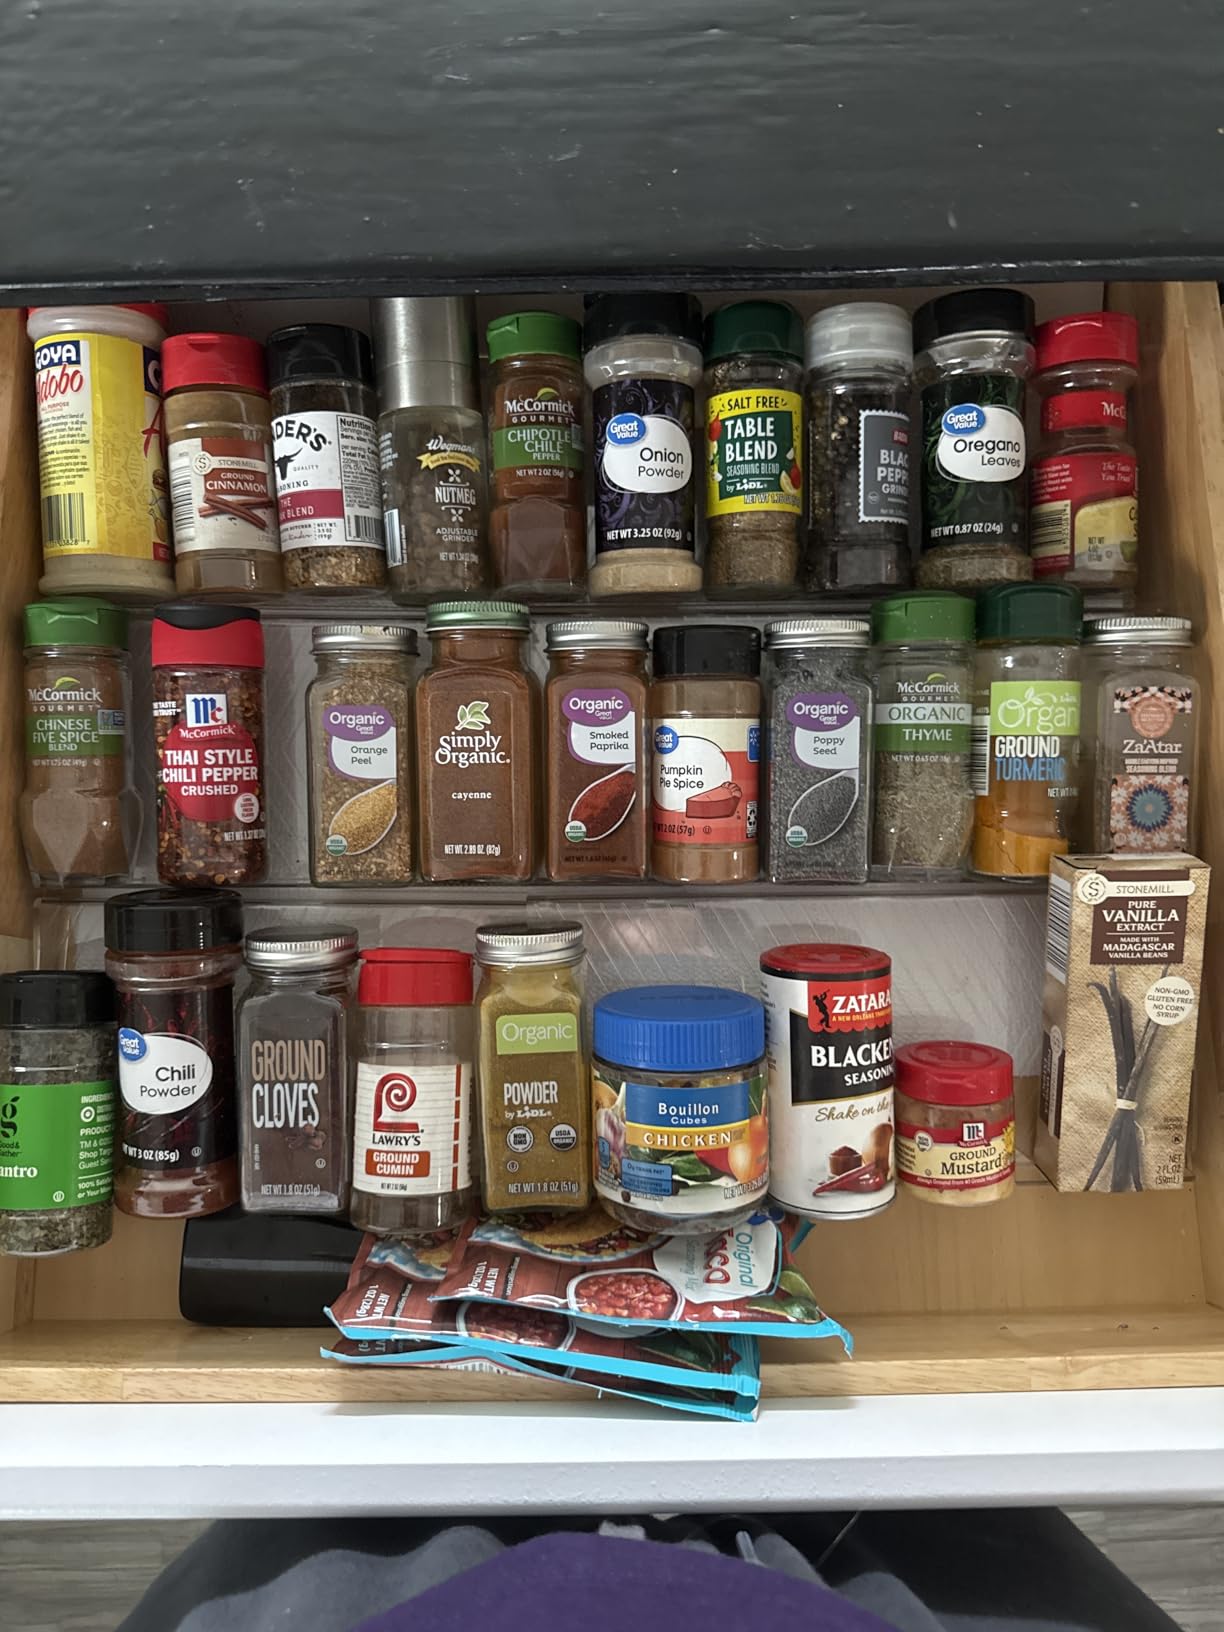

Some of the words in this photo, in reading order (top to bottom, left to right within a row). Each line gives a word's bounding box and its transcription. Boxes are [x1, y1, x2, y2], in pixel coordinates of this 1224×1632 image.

[35, 344, 77, 370] GOYA
[504, 397, 575, 417] McCormick
[727, 396, 752, 411] SALT
[755, 395, 780, 409] FREE
[511, 415, 569, 424] GOURMET
[946, 410, 978, 425] Great
[610, 420, 638, 435] Great
[725, 416, 775, 440] TABLE
[953, 419, 978, 430] Value
[507, 428, 571, 443] CHIPOTLE
[616, 428, 639, 439] Value
[524, 440, 564, 454] CHILE
[725, 440, 778, 463] BLEND
[953, 438, 1020, 457] Oregano
[533, 452, 561, 461] PEPPER
[639, 447, 684, 465] Onion
[981, 454, 1021, 468] Leaves
[293, 464, 319, 472] QUALITY
[516, 468, 526, 477] NET
[527, 469, 537, 477] WT
[638, 465, 684, 479] Powder
[726, 463, 760, 478] SEASONING
[760, 463, 780, 475] BLEND
[220, 472, 255, 481] GROUND
[206, 480, 267, 493] CINNAMON
[726, 484, 736, 493] by
[435, 486, 476, 505] NUTMEG
[286, 505, 314, 519] BLEND
[436, 527, 478, 536] ADJUSTABLE
[606, 528, 619, 541] NET
[619, 528, 632, 540] WT
[632, 528, 652, 539] 3.25
[652, 527, 663, 539] OZ
[663, 527, 682, 541] (92g)
[930, 523, 943, 538] NET
[943, 524, 955, 535] WT
[955, 523, 972, 535] 0.87
[972, 523, 984, 533] OZ
[984, 522, 1004, 534] (24g)
[442, 534, 475, 543] GRINDER
[896, 681, 961, 694] McCormick
[28, 687, 104, 703] McCormick
[33, 704, 95, 713] GOURMET
[569, 696, 624, 714] Organic
[793, 701, 849, 719] Organic
[329, 711, 385, 728] Organic
[888, 706, 966, 721] ORGANIC
[36, 719, 92, 731] CHINESE
[32, 731, 56, 743] FIVE
[59, 731, 100, 743] SPICE
[179, 725, 235, 739] McCormick
[590, 731, 629, 740] Smoked
[655, 732, 673, 743] Great
[902, 728, 953, 741] THYME
[48, 743, 78, 752] BLEND
[439, 730, 502, 755] Simply
[590, 742, 629, 752] Paprika
[813, 736, 845, 746] Poppy
[995, 735, 1060, 758] GROUND
[1121, 739, 1183, 754] Za'Atar
[164, 749, 199, 766] THAI
[204, 748, 253, 766] STYLE
[351, 746, 388, 756] Orange
[813, 746, 837, 755] Seed
[351, 757, 372, 765] Peel
[162, 768, 197, 783] CHILI
[201, 766, 259, 783] PEPPER
[660, 765, 703, 777] Pumpkin
[180, 784, 239, 796] CRUSHED
[660, 777, 671, 788] Pie
[673, 778, 704, 790] Spice
[451, 791, 492, 801] cayenne
[677, 825, 695, 836] (57g)
[444, 844, 454, 855] NET
[1116, 885, 1173, 894] STONEMILL
[1128, 900, 1157, 909] PURE
[1102, 909, 1180, 922] VANILLA
[1116, 922, 1165, 932] EXTRACT
[1102, 942, 1175, 951] MADAGASCAR
[1154, 986, 1190, 995] NON-GMO
[1147, 994, 1176, 1003] GLUTEN
[1165, 1004, 1185, 1012] CORN
[502, 1022, 573, 1045] Organic
[119, 1033, 140, 1048] Great
[252, 1039, 326, 1082] GROUND
[155, 1064, 196, 1082] Chili
[139, 1084, 198, 1098] Powder
[503, 1081, 559, 1105] POWDER
[252, 1082, 320, 1129] CLOVES
[658, 1103, 719, 1116] Bouillon
[815, 1103, 860, 1122] Shake
[861, 1105, 875, 1115] on
[876, 1098, 889, 1112] the
[504, 1111, 515, 1121] by
[670, 1117, 708, 1125] Cubes
[554, 1129, 571, 1137] USDA
[643, 1131, 733, 1147] CHICKEN
[372, 1133, 421, 1147] LAWRY'S
[513, 1138, 527, 1146] GMO
[80, 1151, 98, 1160] Shop
[128, 1146, 137, 1158] WT
[137, 1148, 143, 1159] 3
[144, 1149, 154, 1160] OZ
[154, 1149, 180, 1163] (85g)
[372, 1151, 420, 1164] GROUND
[949, 1146, 997, 1161] GROUND
[79, 1159, 100, 1170] Guest
[376, 1163, 414, 1176] CUMIN
[940, 1154, 1002, 1176] Mustard
[79, 1180, 95, 1190] 100%
[260, 1184, 273, 1195] NET
[272, 1184, 282, 1196] WT
[283, 1185, 294, 1195] 1.8
[294, 1185, 304, 1196] OZ
[508, 1183, 522, 1194] NET
[522, 1182, 536, 1193] WT
[537, 1182, 548, 1193] 1.8
[549, 1182, 560, 1193] OZ
[560, 1181, 579, 1195] (51g)
[723, 1185, 738, 1200] NET
[733, 1232, 758, 1288] Original
[487, 1267, 500, 1279] NET
[483, 1279, 497, 1293] WT
[364, 1289, 377, 1298] OZ
[376, 1293, 391, 1306] NET
